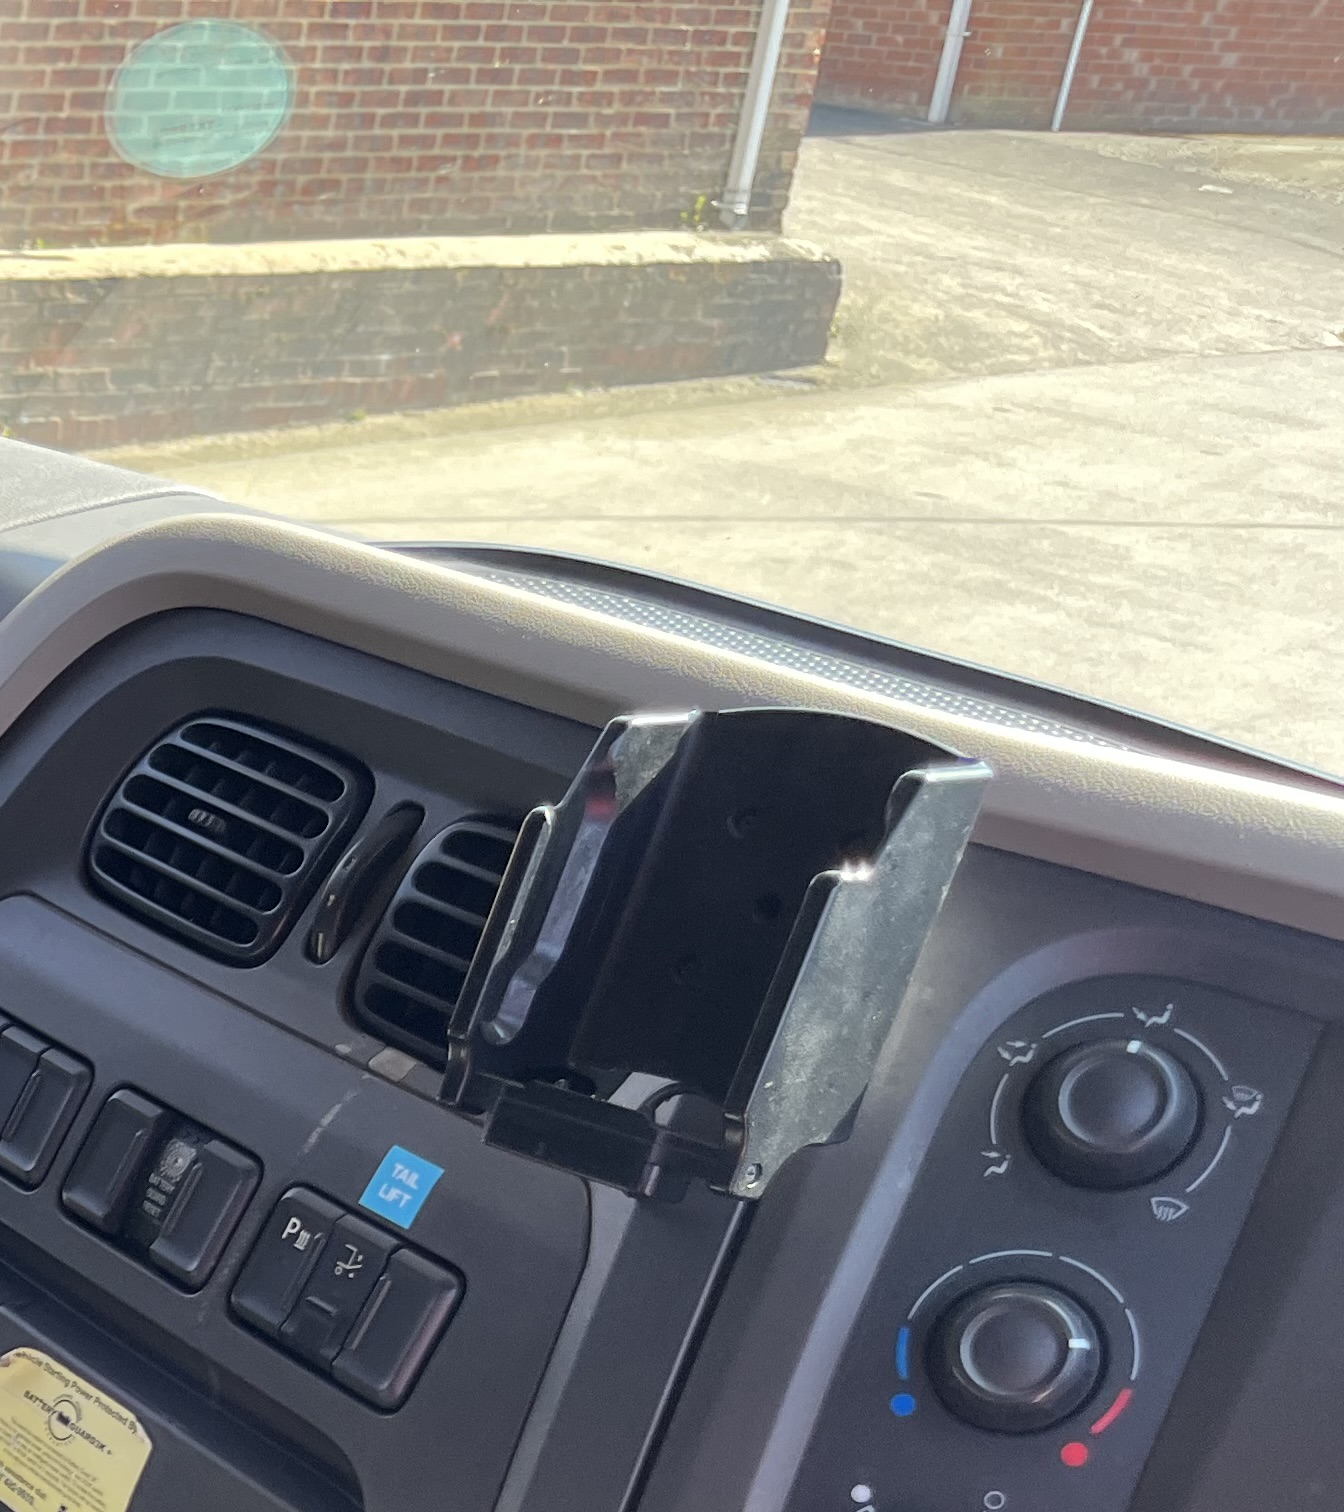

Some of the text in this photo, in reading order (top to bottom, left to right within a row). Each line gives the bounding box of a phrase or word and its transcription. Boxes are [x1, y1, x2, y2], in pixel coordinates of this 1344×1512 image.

[392, 1163, 419, 1190] TAIL
[378, 1183, 412, 1208] LIFT
[70, 1380, 93, 1401] Power
